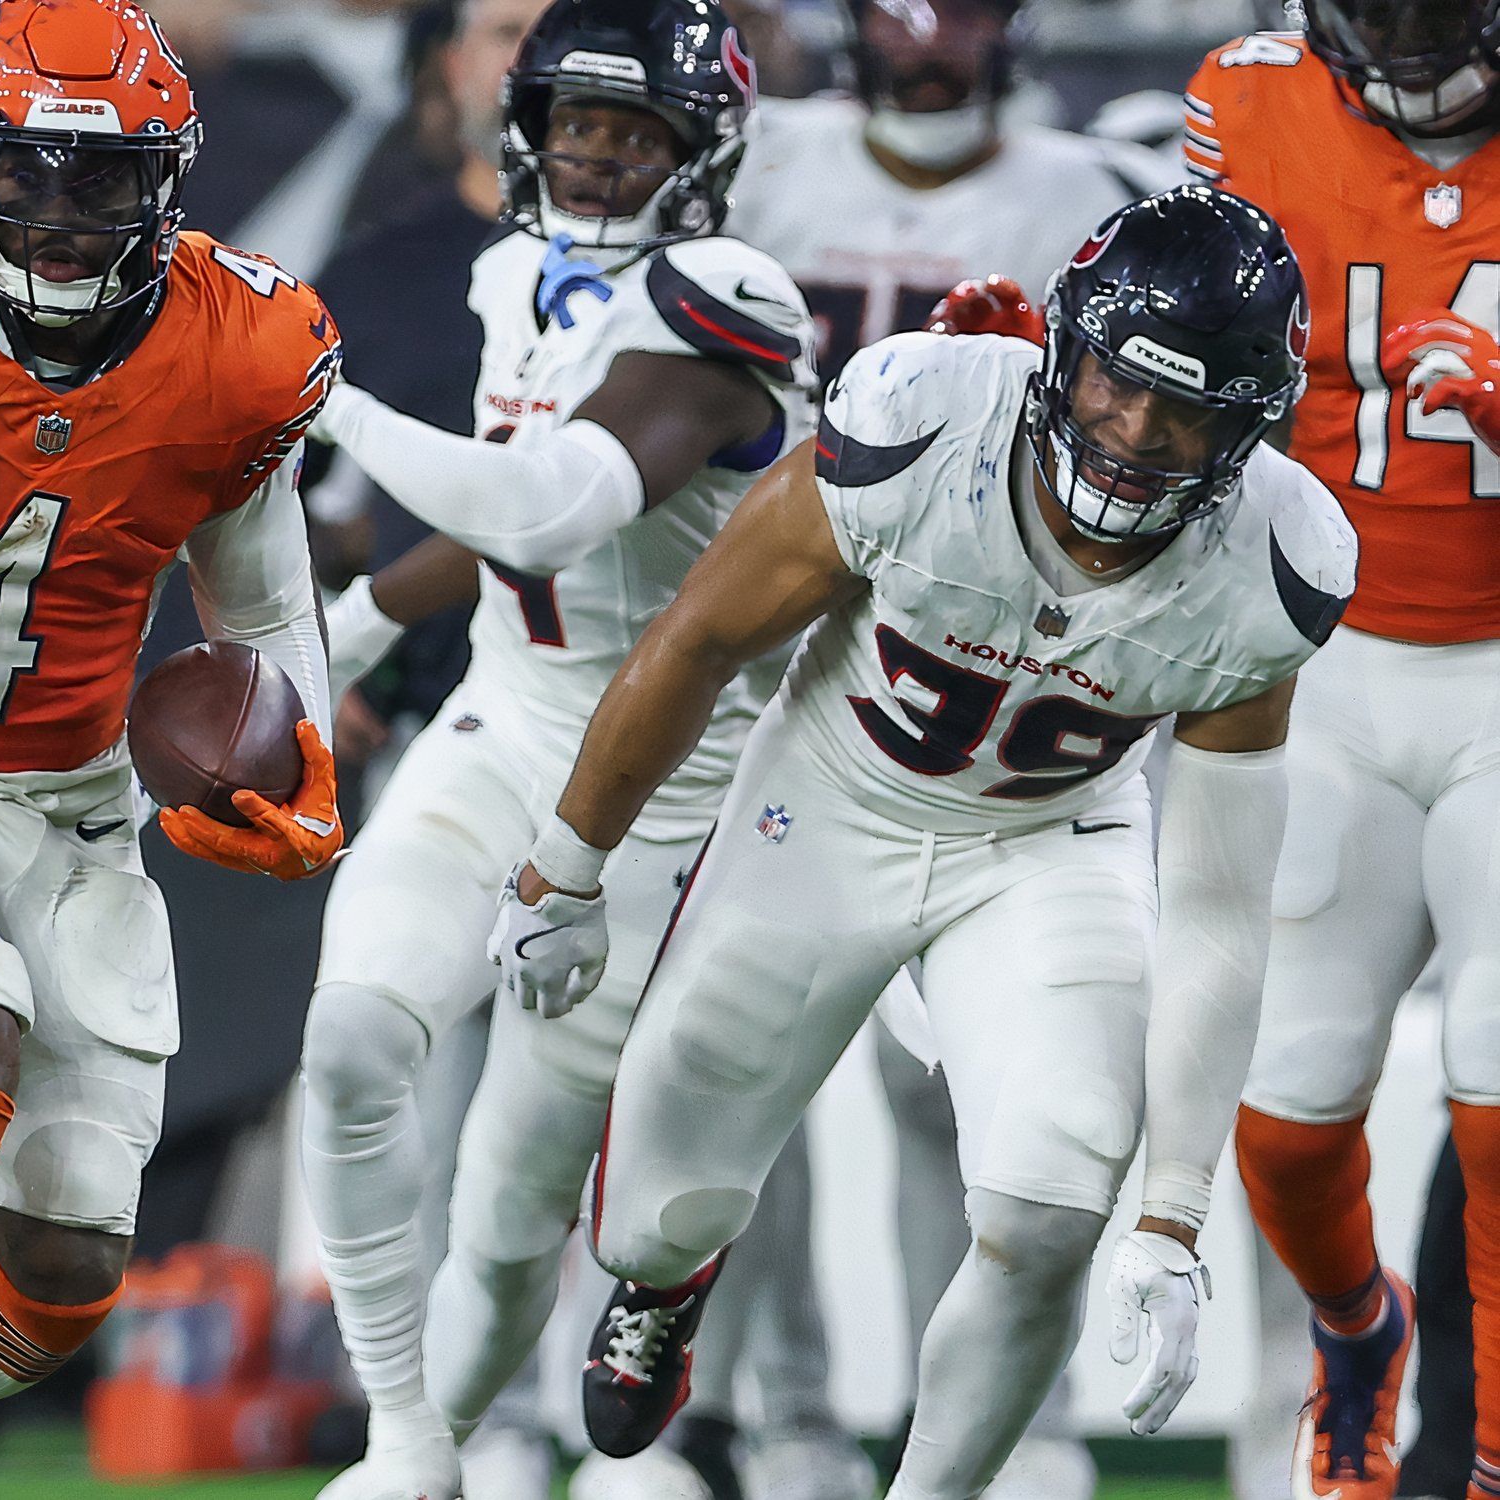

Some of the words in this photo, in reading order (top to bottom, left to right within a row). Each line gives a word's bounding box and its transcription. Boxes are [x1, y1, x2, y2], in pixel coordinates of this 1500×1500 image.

[210, 245, 298, 300] 4
[943, 633, 1116, 702] HOUSTON
[845, 623, 1176, 800] 39
